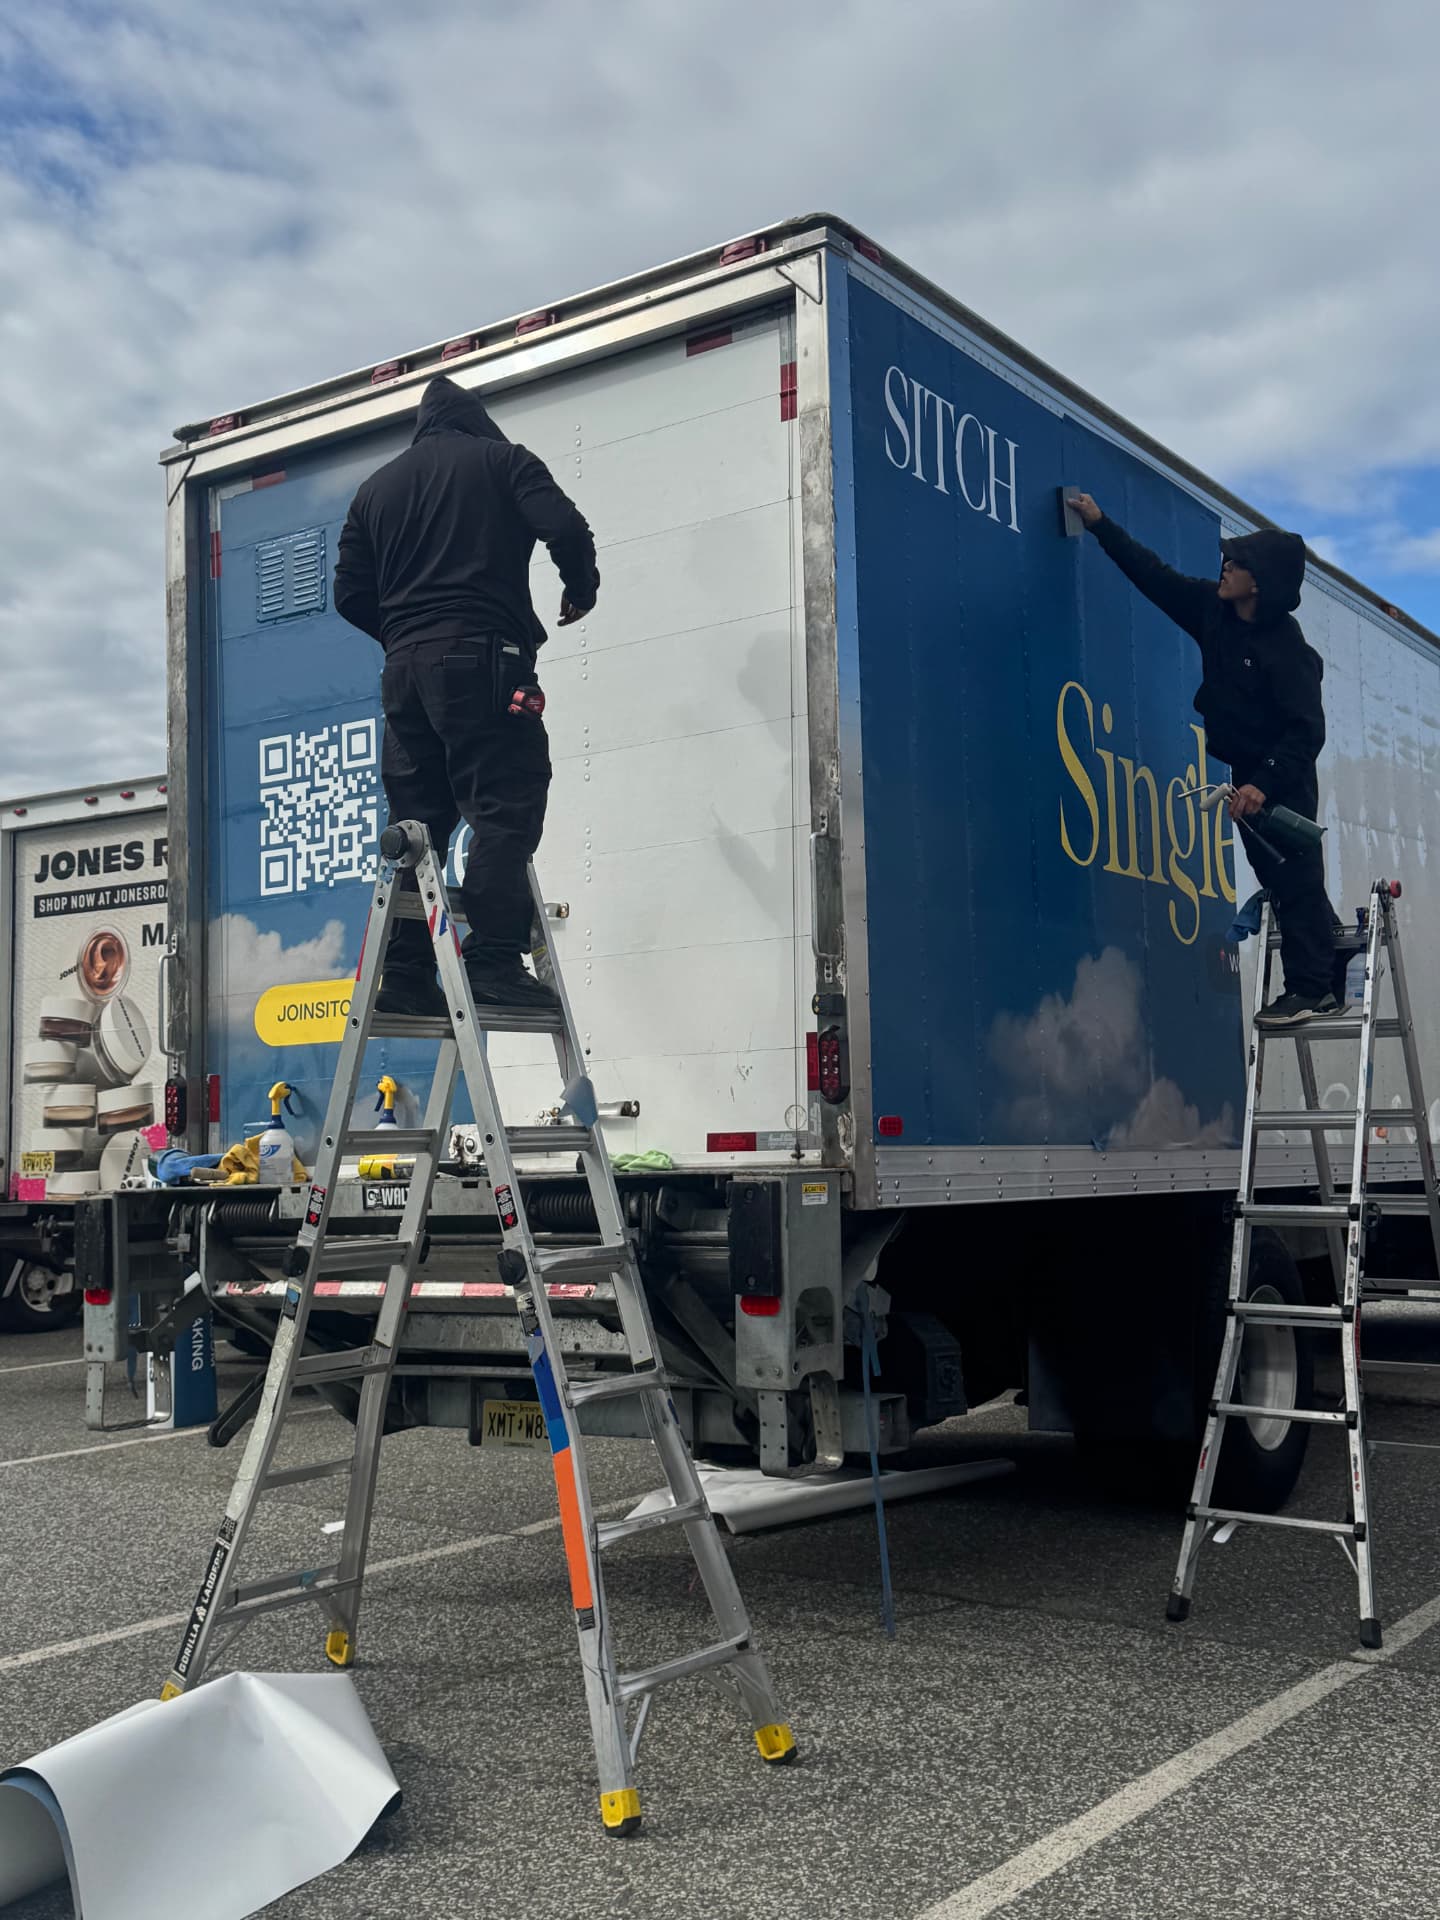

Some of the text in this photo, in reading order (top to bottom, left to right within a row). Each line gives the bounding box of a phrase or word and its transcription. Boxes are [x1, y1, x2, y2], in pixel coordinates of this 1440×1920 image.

[884, 365, 1021, 533] SITCH
[34, 840, 145, 883] JONES
[39, 884, 168, 912] SHOP NOW AT JONESRO
[142, 922, 168, 947] M
[381, 1187, 410, 1206] WAL
[487, 1412, 549, 1440] XMT W8
[178, 1622, 202, 1674] GORILLA
